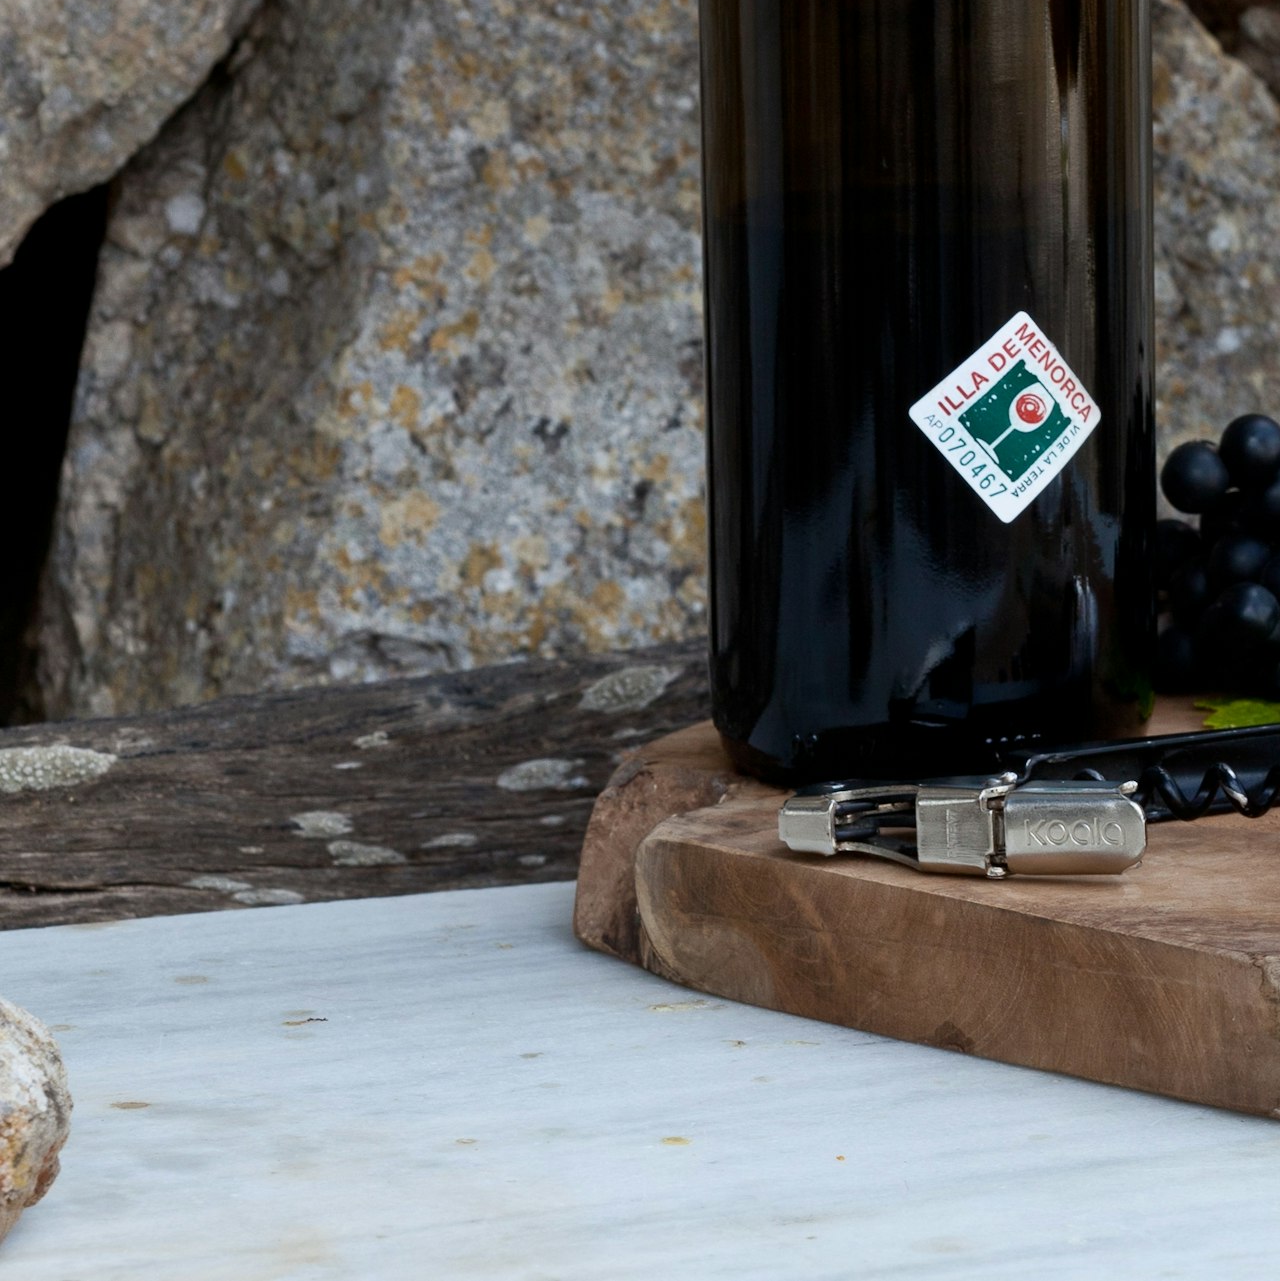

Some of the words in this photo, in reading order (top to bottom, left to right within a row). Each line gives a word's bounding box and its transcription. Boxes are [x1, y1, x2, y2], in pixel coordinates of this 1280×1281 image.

[938, 371, 990, 416] ILLA
[988, 339, 1021, 372] DE
[1015, 322, 1093, 423] MENORCA
[1069, 424, 1081, 438] VI
[1056, 436, 1071, 452] DE
[1044, 451, 1057, 465] LA
[1010, 466, 1044, 499] TERRA
